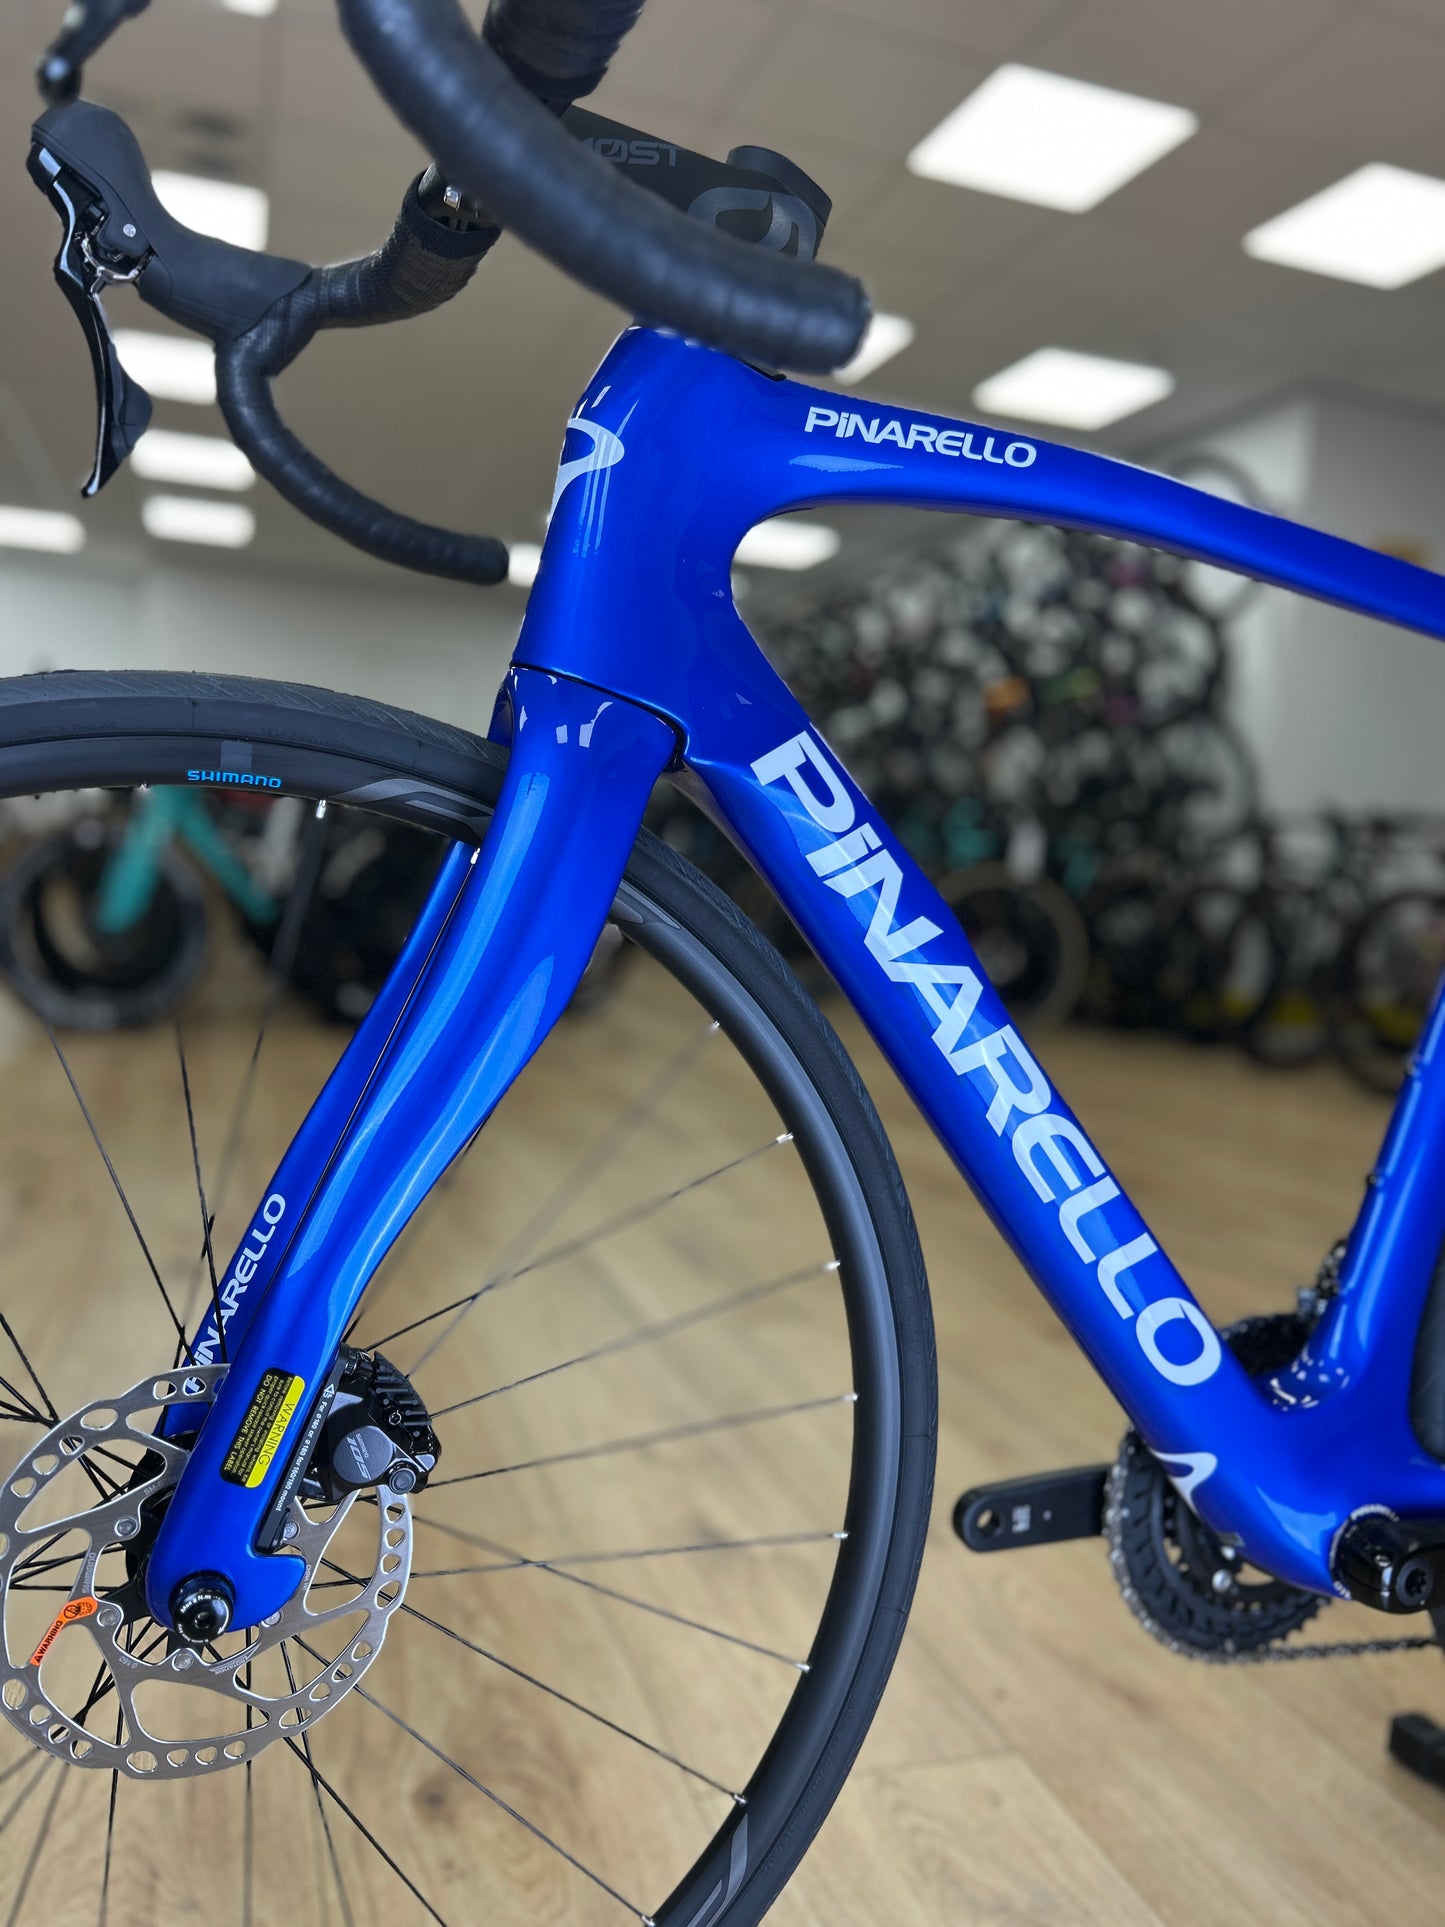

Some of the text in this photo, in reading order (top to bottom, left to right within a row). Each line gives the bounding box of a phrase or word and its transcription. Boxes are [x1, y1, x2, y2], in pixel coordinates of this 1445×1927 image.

[581, 137, 677, 168] OST
[187, 769, 282, 789] SHIMANO
[318, 1401, 327, 1412] For
[223, 1373, 272, 1472] DO NOT REMOVE THIS LABEL
[258, 1404, 295, 1466] WARNING
[307, 1430, 314, 1438] or
[295, 1456, 304, 1466] for
[346, 1437, 371, 1479] 105
[275, 1490, 288, 1512] mount
[37, 1619, 63, 1656] WARNING
